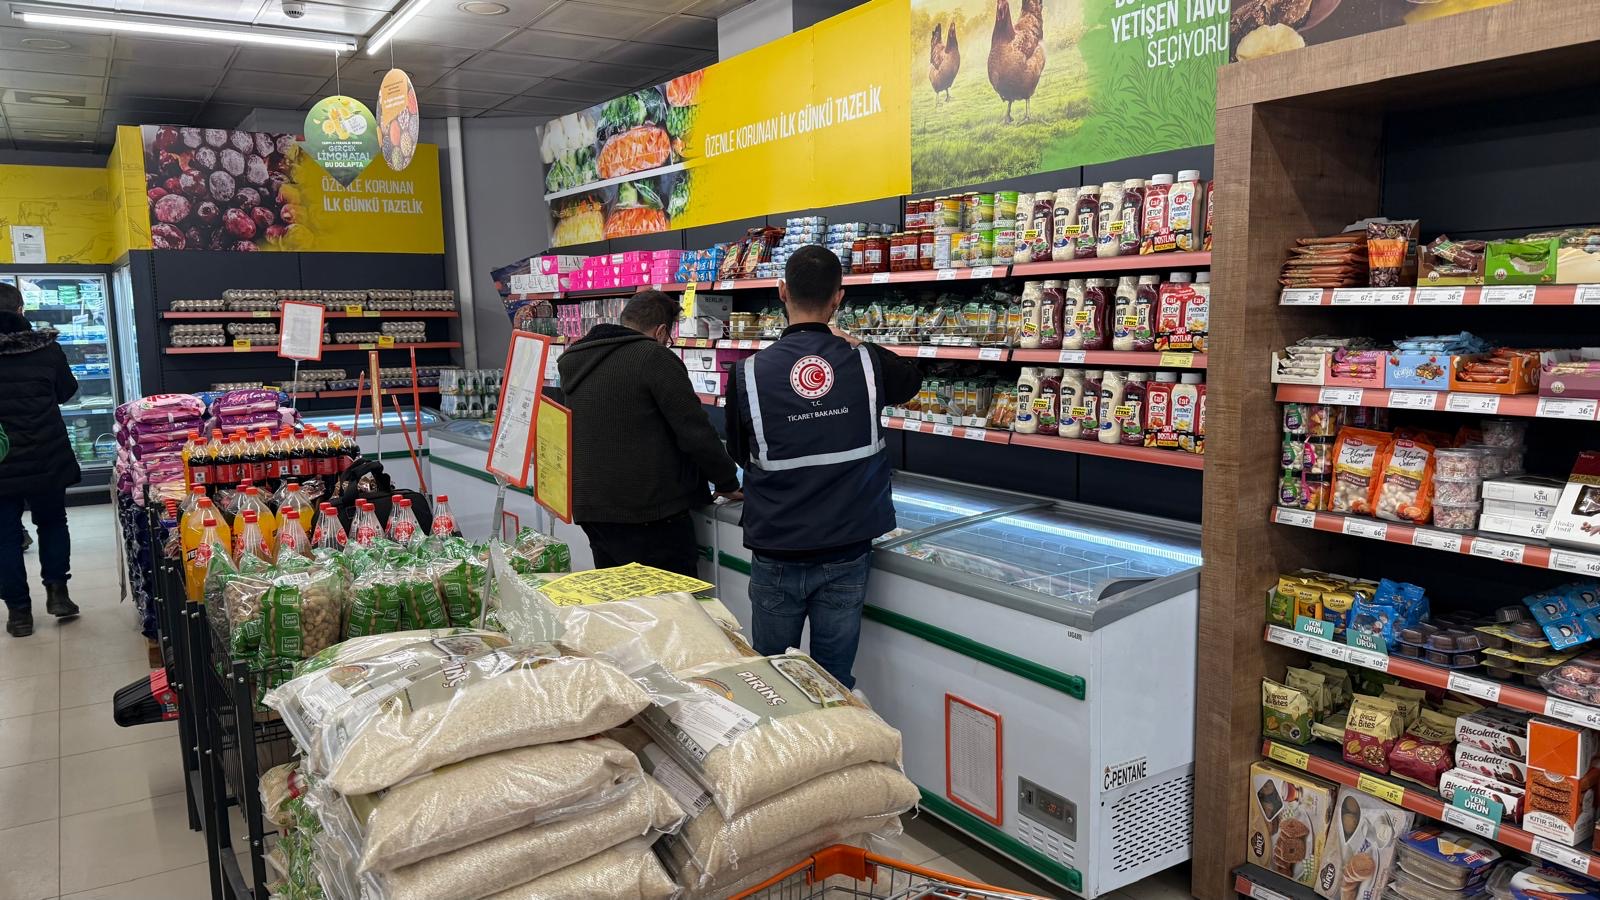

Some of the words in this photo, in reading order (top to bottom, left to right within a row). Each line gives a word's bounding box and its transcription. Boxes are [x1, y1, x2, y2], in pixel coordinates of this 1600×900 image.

[1111, 0, 1178, 43] YETİŞEN
[705, 130, 735, 158] ÖZENLE
[736, 117, 778, 151] KORUNAN
[779, 111, 796, 139] İLK
[797, 98, 834, 133] GÜNKÜ
[835, 85, 881, 123] TAZELİK
[328, 145, 357, 153] GERÇEK
[317, 150, 370, 161] LİMONATA!
[365, 178, 414, 194] KORUNAN
[323, 195, 341, 212] İLK
[343, 198, 380, 213] GÜNKÜ
[382, 199, 423, 214] TAZELİK
[1154, 234, 1175, 244] DOSTLAR
[1170, 335, 1192, 343] DOSTLAR
[787, 411, 814, 422] TİCARET
[814, 406, 849, 419] BAKANLIĞI
[1578, 407, 1588, 415] 36
[1534, 492, 1548, 502] kral
[1534, 510, 1548, 519] kral
[1530, 526, 1545, 536] kral
[1443, 541, 1451, 549] 32
[1500, 549, 1514, 558] 219
[1586, 563, 1600, 572] 149
[1309, 619, 1321, 627] YENİ
[1304, 624, 1324, 635] ÜRÜN
[1360, 634, 1373, 642] YENİ
[1356, 638, 1377, 650] ÜRÜN
[736, 670, 787, 707] PİRİNÇ
[1486, 688, 1491, 696] 7
[1271, 693, 1288, 701] Bread
[1272, 699, 1289, 707] Bites
[1360, 713, 1377, 722] Bread
[1587, 715, 1597, 723] 64
[1358, 719, 1376, 729] Bites
[1460, 725, 1500, 739] Biscolata
[1460, 751, 1502, 765] Biscolata
[1104, 761, 1147, 790] C-PENTANE
[1444, 781, 1486, 796] Biscolata
[1469, 794, 1486, 805] YENİ
[1464, 799, 1489, 815] ÜRÜN
[1475, 823, 1484, 832] 59
[1529, 815, 1547, 826] KITIR
[1547, 821, 1567, 832] SİMİT
[1571, 858, 1581, 866] 44
